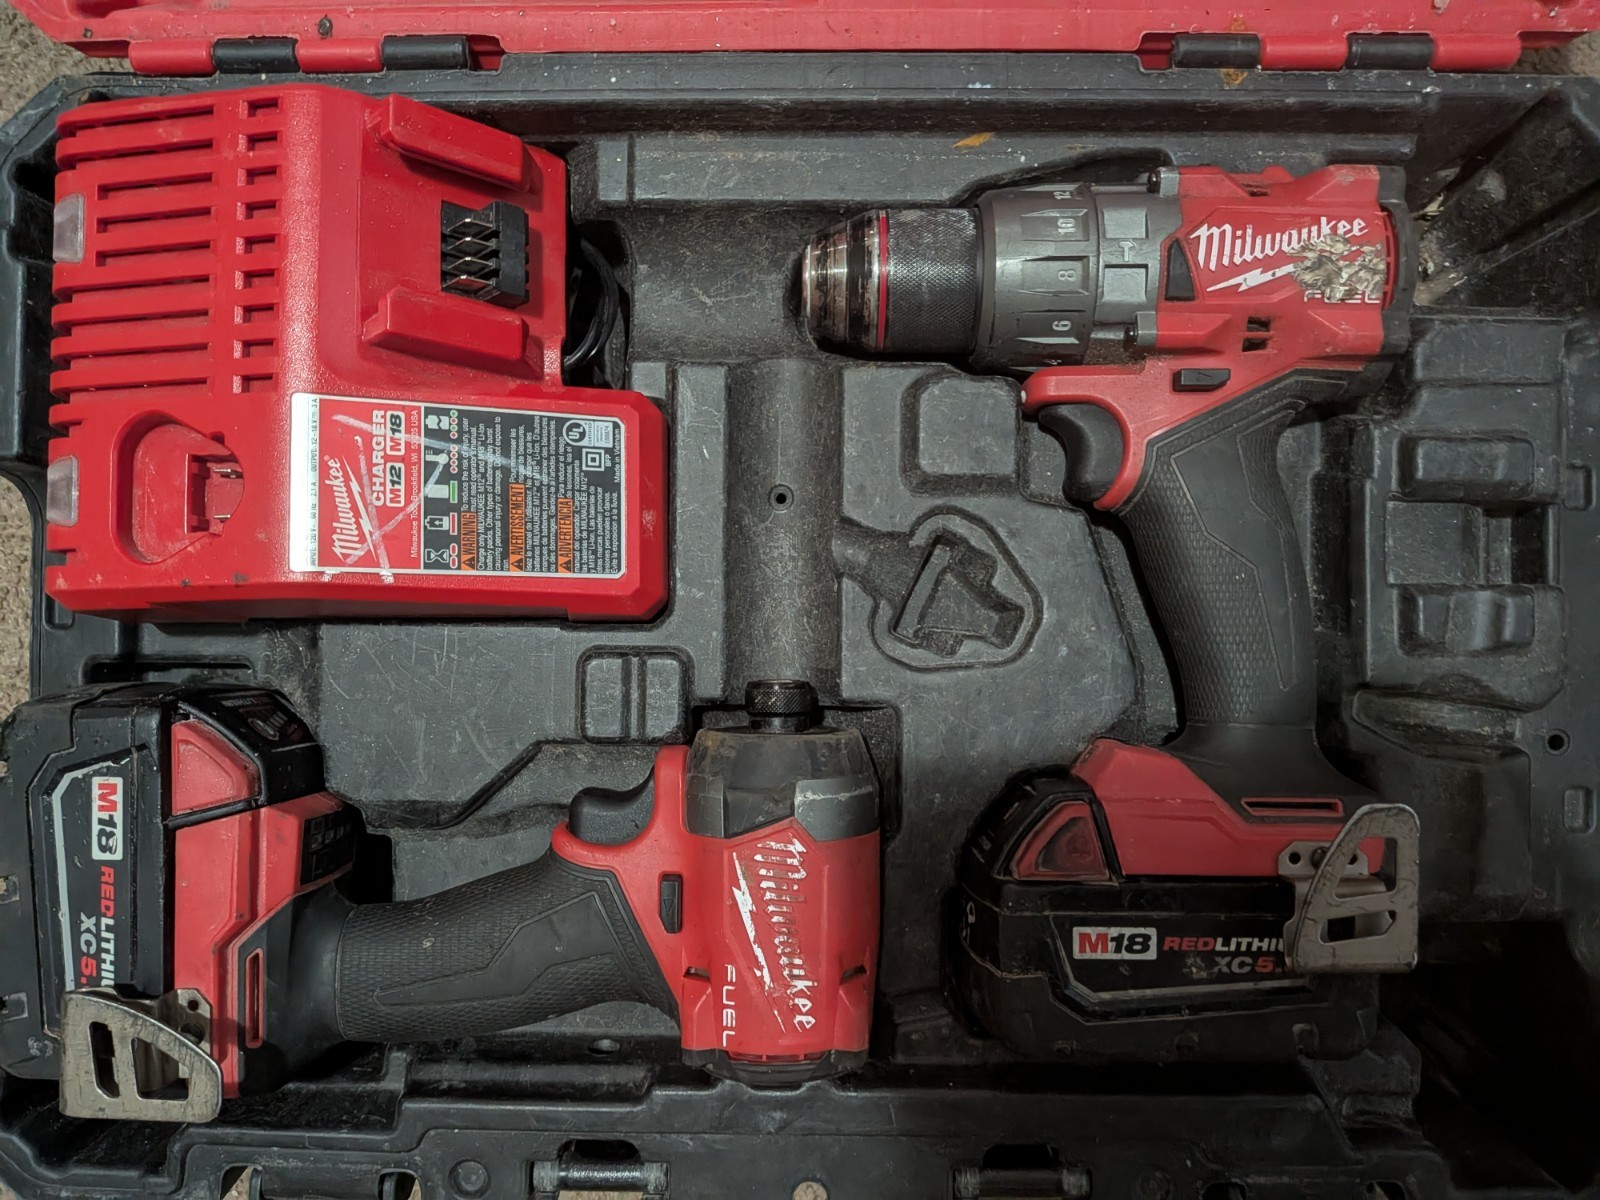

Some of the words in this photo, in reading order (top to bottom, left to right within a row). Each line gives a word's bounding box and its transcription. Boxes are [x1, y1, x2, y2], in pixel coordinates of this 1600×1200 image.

[1058, 218, 1076, 235] 10
[1190, 216, 1369, 271] Milwaukee
[1058, 270, 1076, 281] 8
[1052, 320, 1071, 331] 6
[390, 414, 401, 451] M18
[517, 425, 526, 455] blessures,
[568, 426, 583, 439] UL
[558, 437, 566, 454] riesgo
[373, 410, 384, 506] CHARGER
[411, 453, 418, 462] WI
[390, 465, 401, 504] M12
[494, 468, 502, 495] damage.
[526, 479, 532, 488] Ne
[566, 464, 574, 490] lesiones,
[589, 486, 595, 494] de
[311, 503, 316, 511] Hz
[325, 457, 363, 561] Milwaukee
[486, 493, 494, 510] types
[494, 503, 502, 520] injury
[511, 486, 523, 556] AVERTISSEMENT
[526, 522, 532, 530] de
[559, 501, 571, 558] ADVERTENCIA
[596, 513, 604, 535] pueden
[462, 514, 475, 556] WARNING
[478, 534, 486, 547] only
[486, 529, 494, 549] packs.
[494, 520, 502, 546] personal
[541, 537, 548, 545] de
[549, 517, 557, 551] dommages.
[581, 531, 587, 539] de
[604, 517, 612, 549] personales
[478, 548, 486, 569] Charge
[486, 550, 494, 570] battery
[494, 548, 502, 570] causing
[97, 783, 118, 856] M18
[81, 911, 96, 988] XC5.
[1078, 932, 1151, 954] M18
[1213, 956, 1284, 973] XC5.
[722, 964, 736, 1047] FUEL
